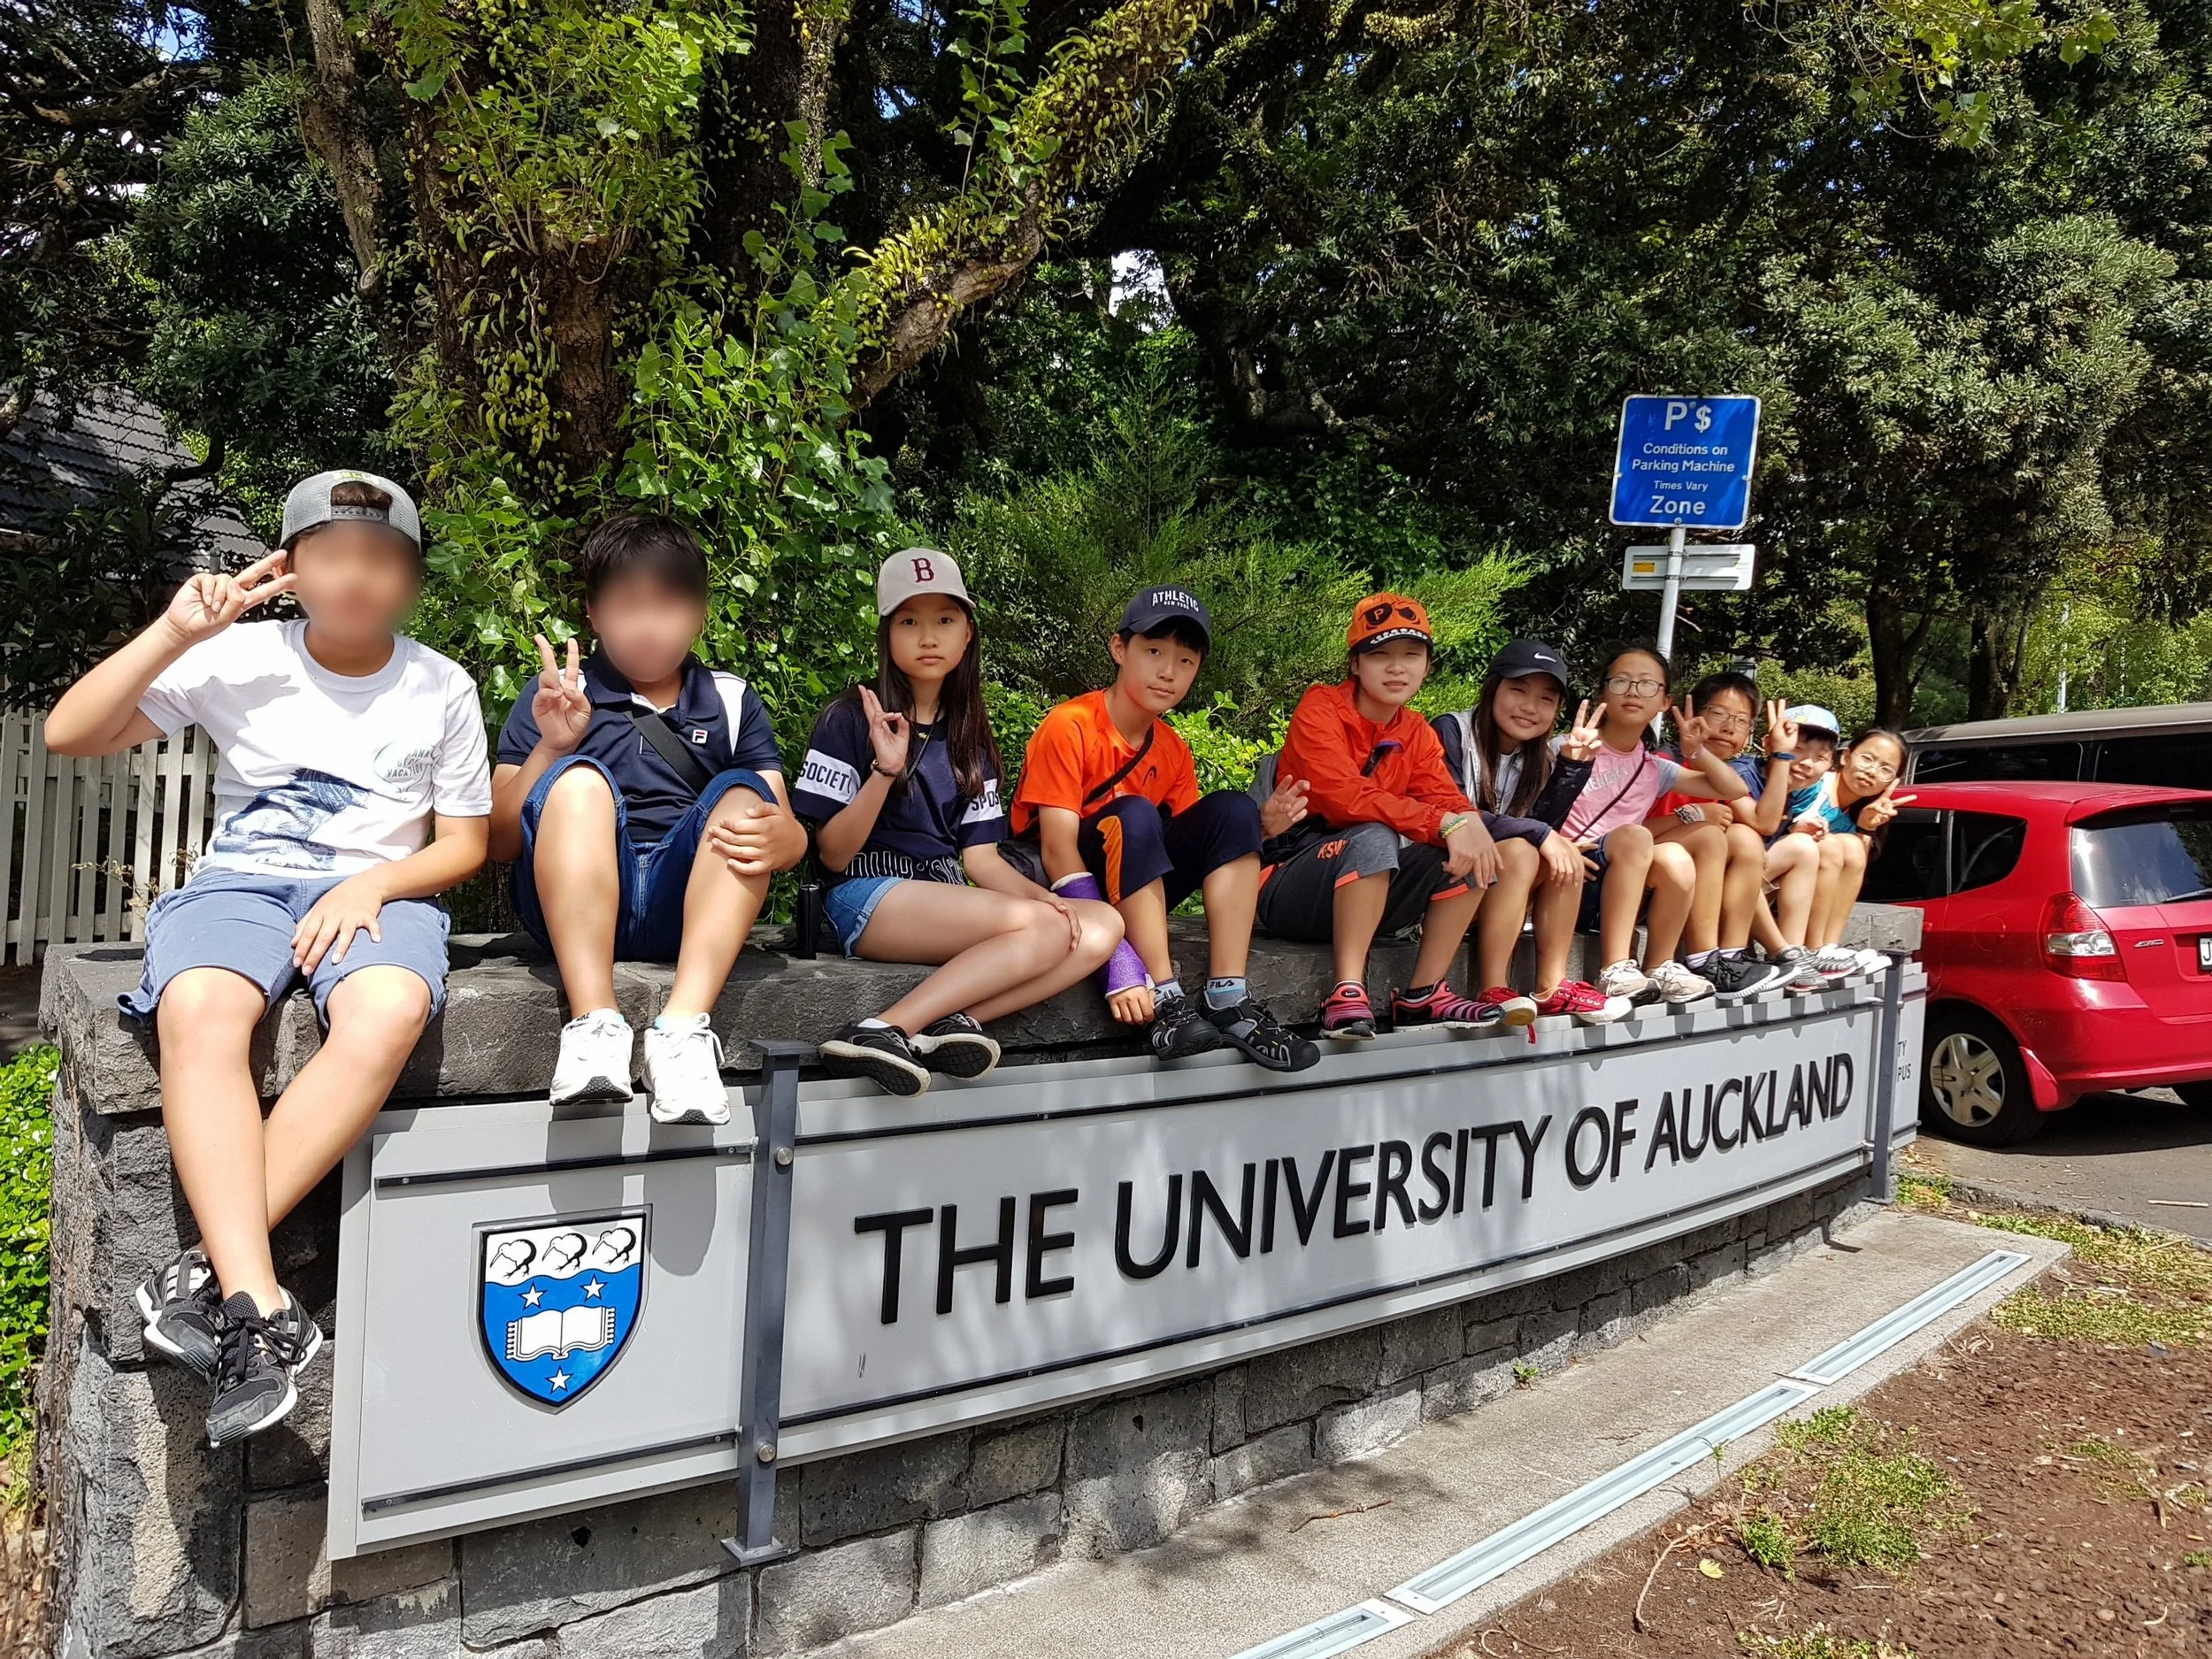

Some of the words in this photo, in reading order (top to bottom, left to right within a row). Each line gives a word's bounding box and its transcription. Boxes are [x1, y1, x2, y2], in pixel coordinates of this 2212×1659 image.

[1643, 442, 1708, 455] Conditions
[1711, 446, 1728, 456] on
[1632, 459, 1679, 473] Parking
[1681, 460, 1735, 472] Machine
[1654, 480, 1682, 490] Times
[1686, 481, 1709, 492] Vary
[1649, 495, 1706, 515] Zone
[910, 557, 934, 583] B
[1152, 590, 1199, 612] ATHLETIC
[1210, 979, 1235, 989] FILA
[1897, 1063, 1911, 1083] PUS
[854, 1187, 1079, 1325] THE
[1115, 1114, 1553, 1279] UNIVERSITY
[1564, 1098, 1639, 1187] OF
[1643, 1052, 1855, 1171] AUCKLAND
